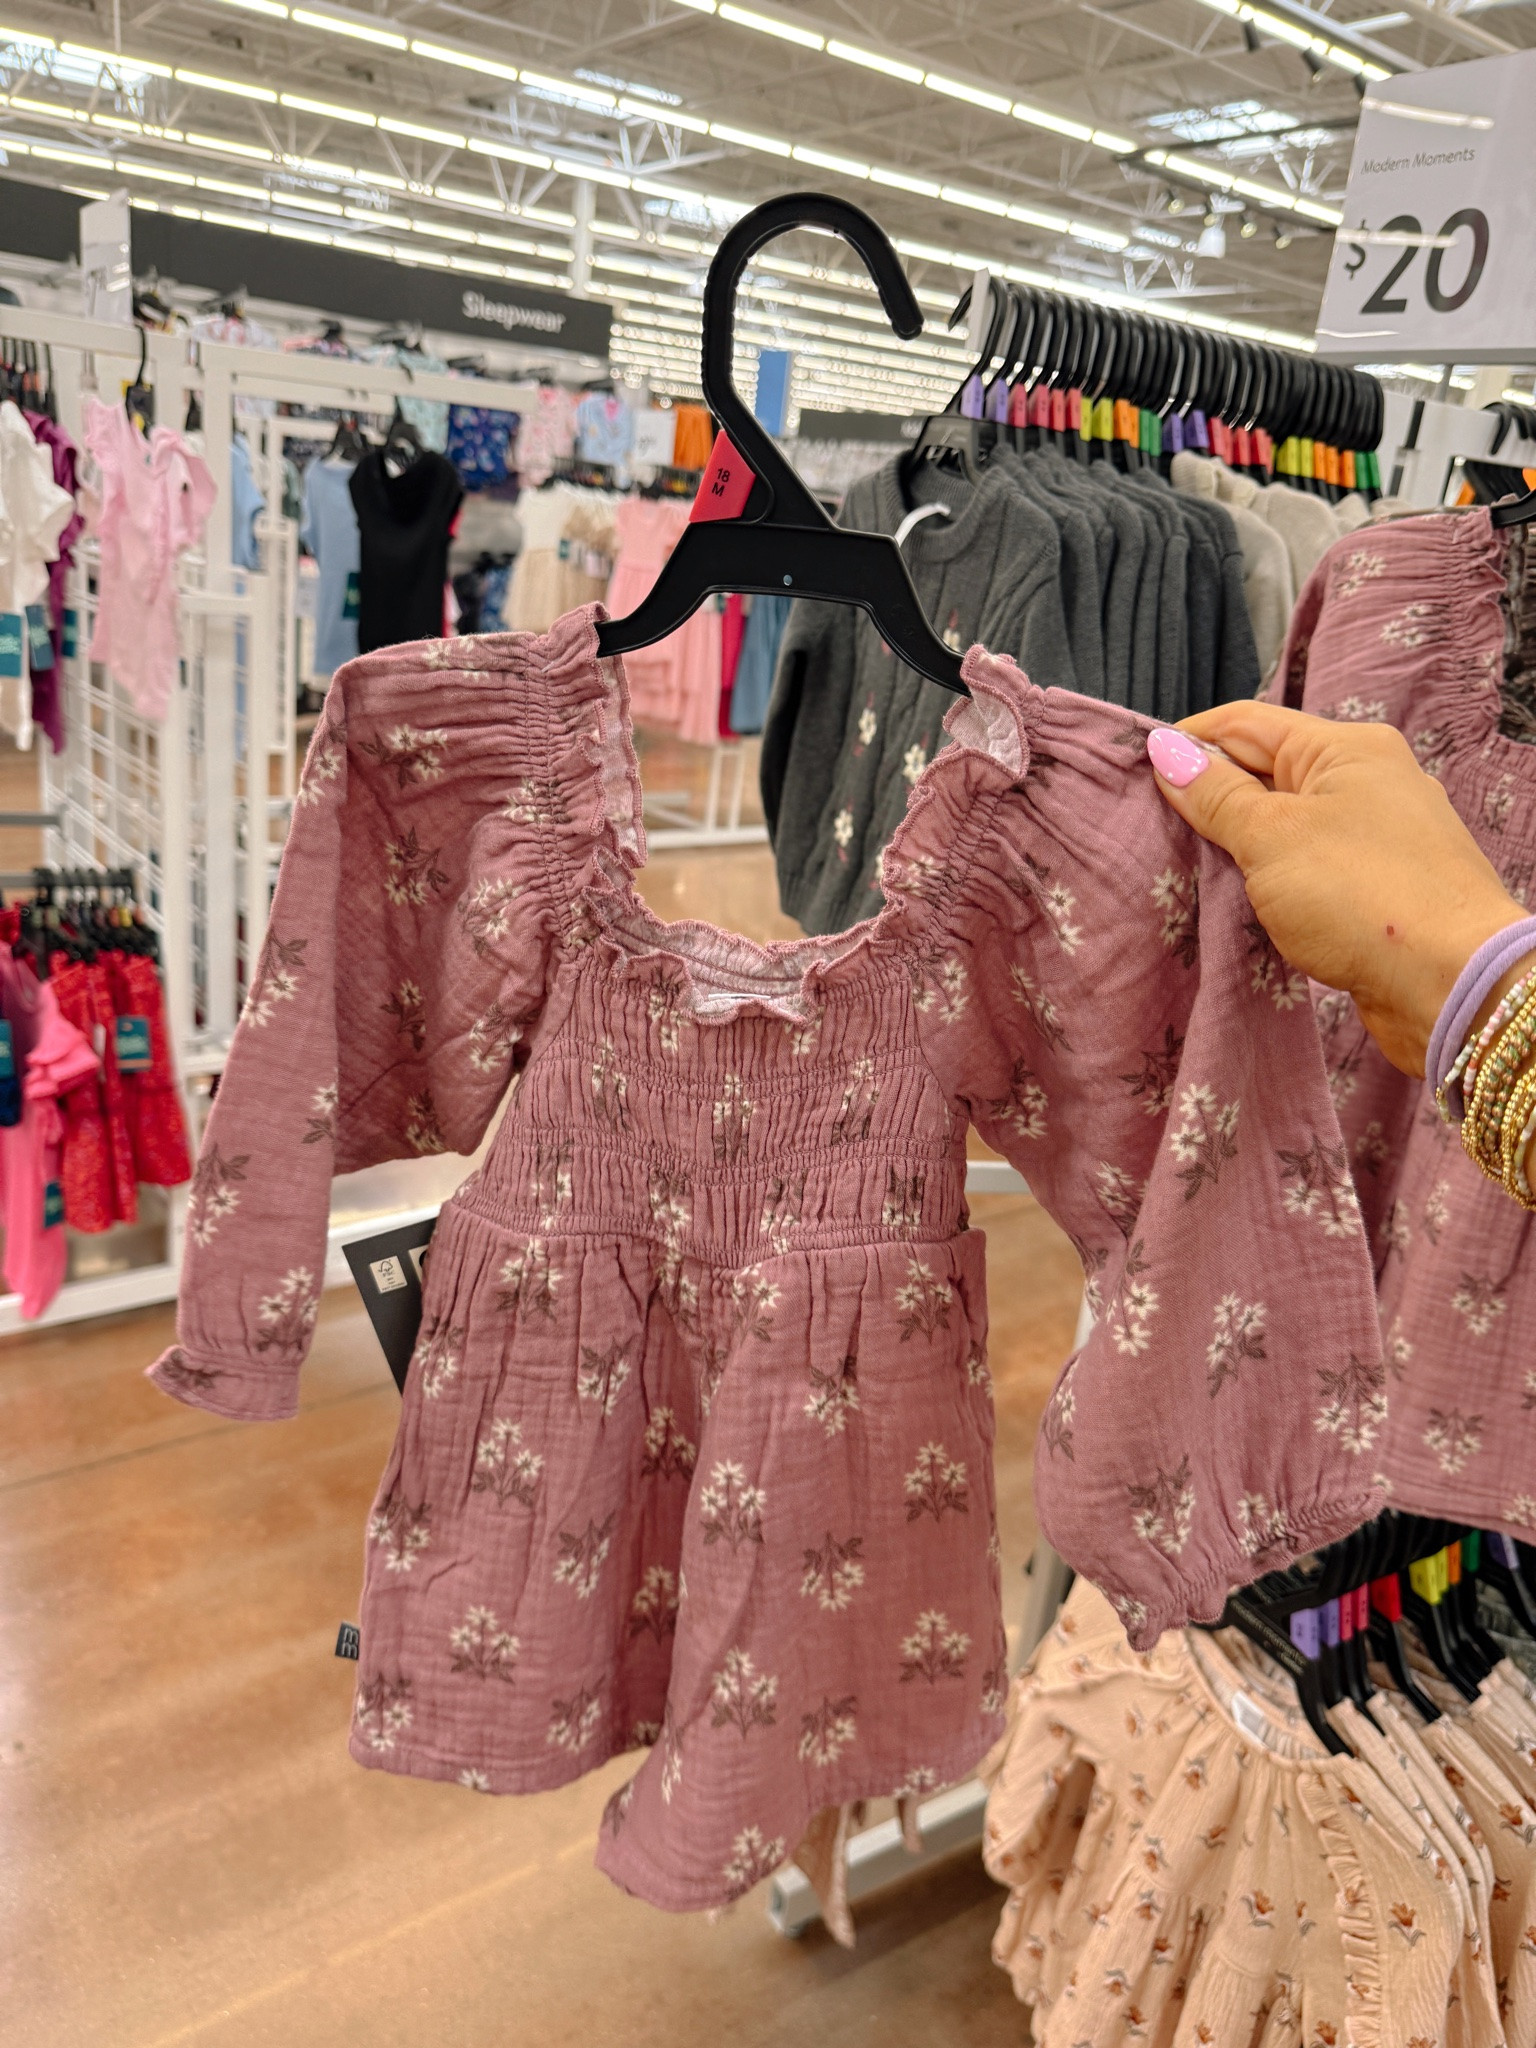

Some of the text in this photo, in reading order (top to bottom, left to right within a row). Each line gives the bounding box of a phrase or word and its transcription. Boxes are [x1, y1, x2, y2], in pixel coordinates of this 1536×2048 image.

[1361, 147, 1475, 175] Modern Moments
[462, 290, 566, 333] Sleepwear
[717, 467, 731, 483] 18
[711, 481, 725, 497] M
